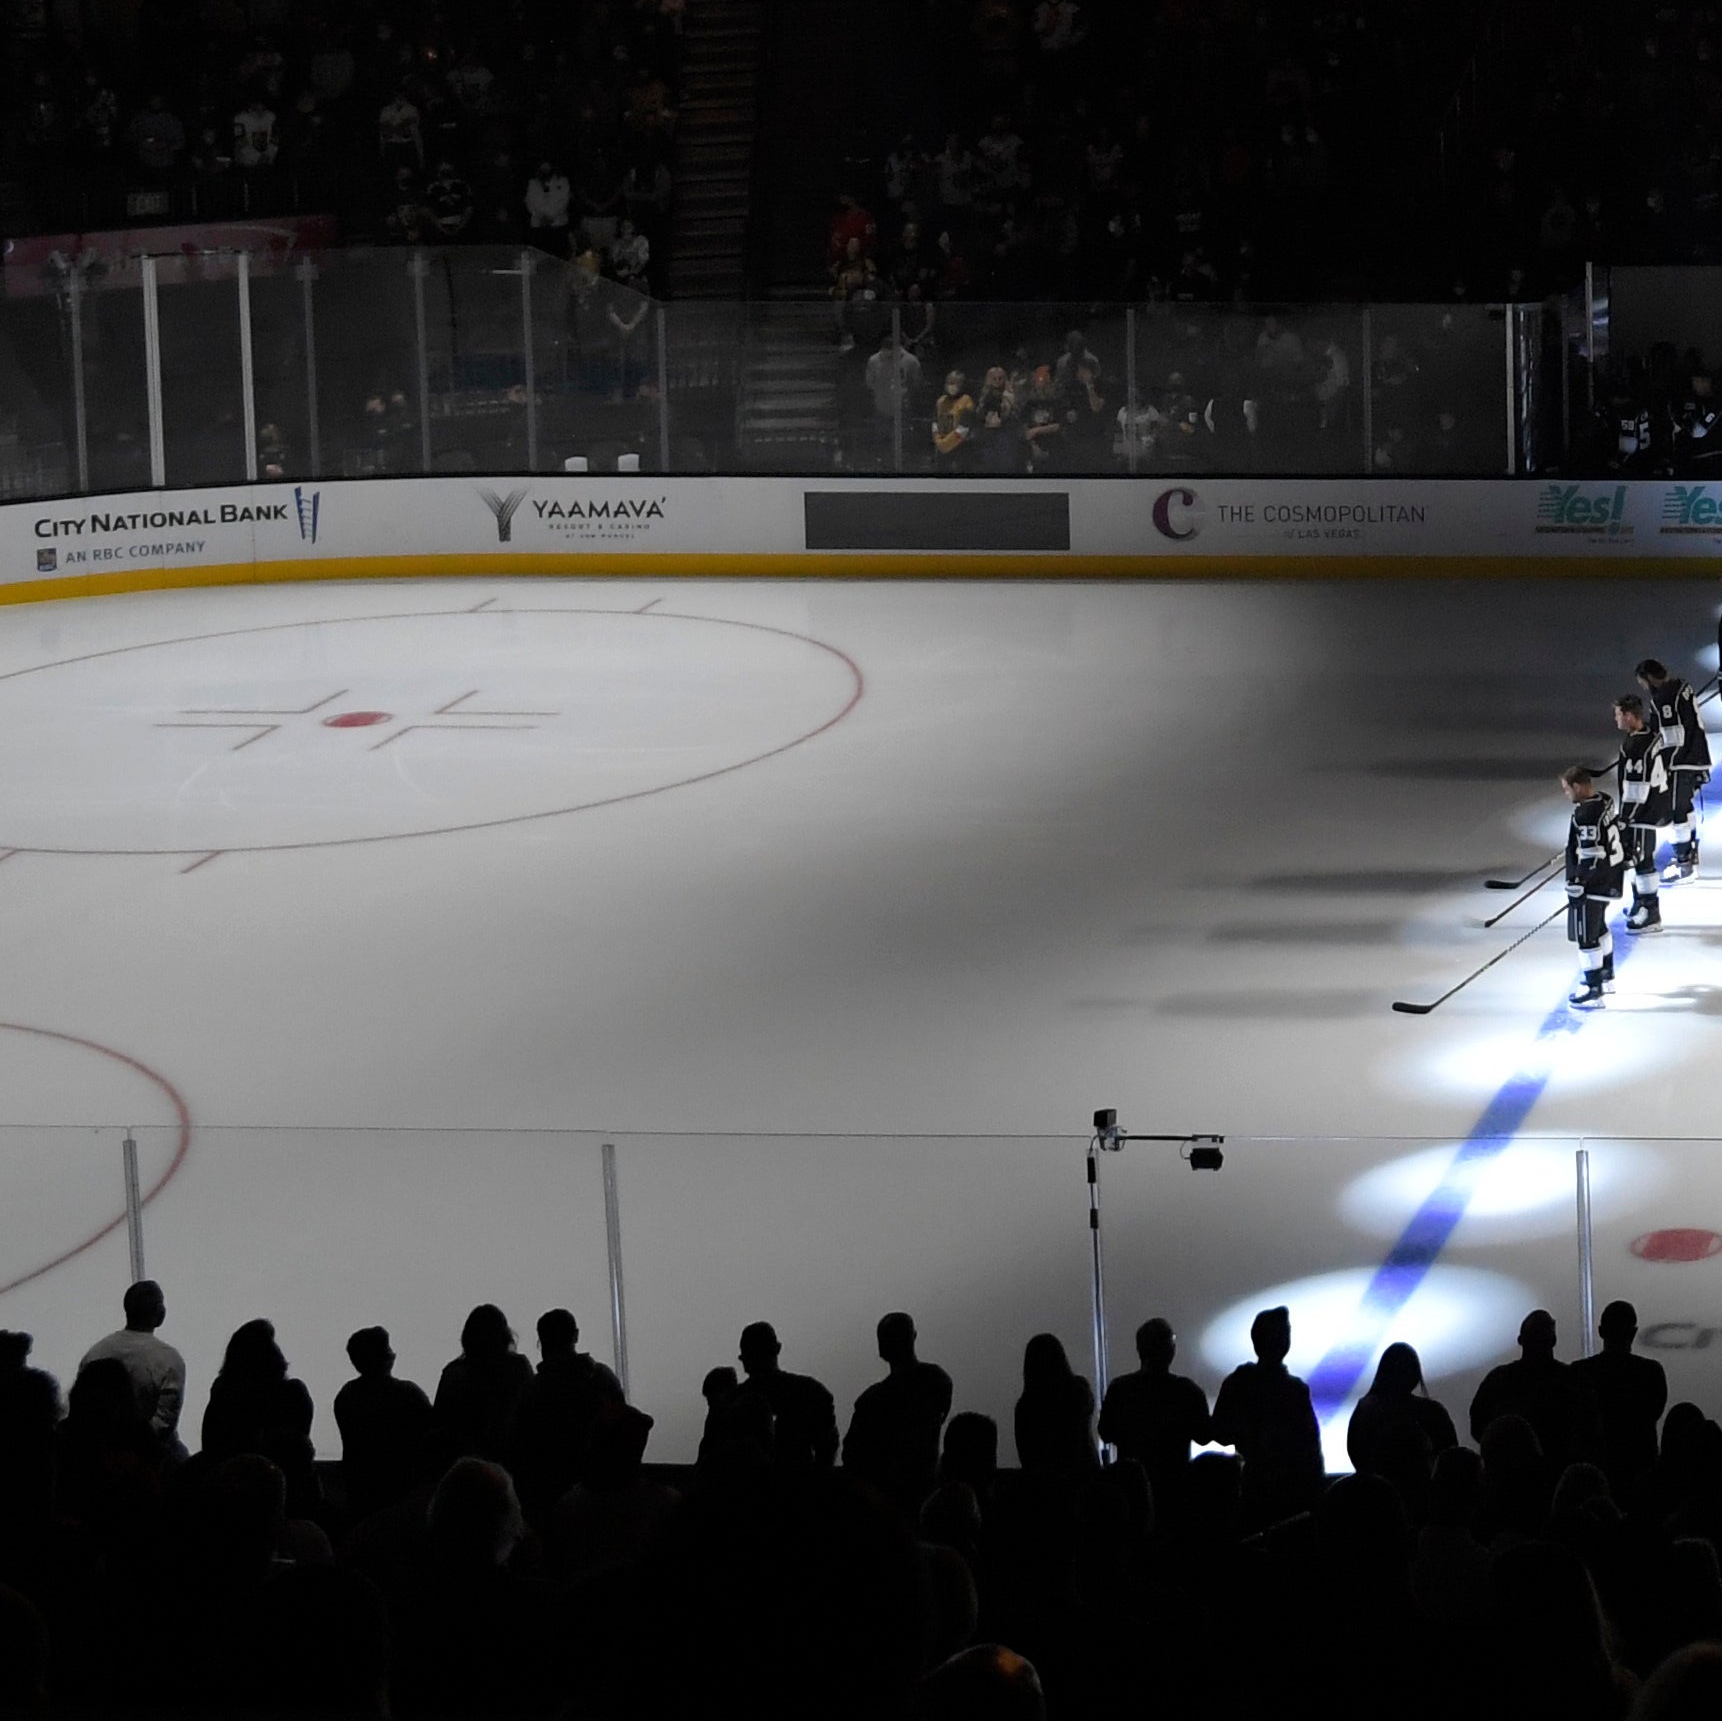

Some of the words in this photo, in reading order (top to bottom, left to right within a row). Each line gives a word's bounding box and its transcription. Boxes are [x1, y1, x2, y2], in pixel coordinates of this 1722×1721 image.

[1218, 506, 1254, 524] THE
[1263, 505, 1427, 524] COSMOPOLITAN
[1549, 484, 1626, 535] Yes!
[34, 517, 91, 538] CITY
[91, 509, 217, 535] NATIONAL
[219, 504, 288, 525] BANK
[65, 551, 87, 564] AN
[92, 547, 123, 562] RBC
[128, 541, 205, 559] COMPANY
[1661, 704, 1673, 719] 8
[1625, 758, 1643, 774] 44
[1578, 826, 1597, 841] 33
